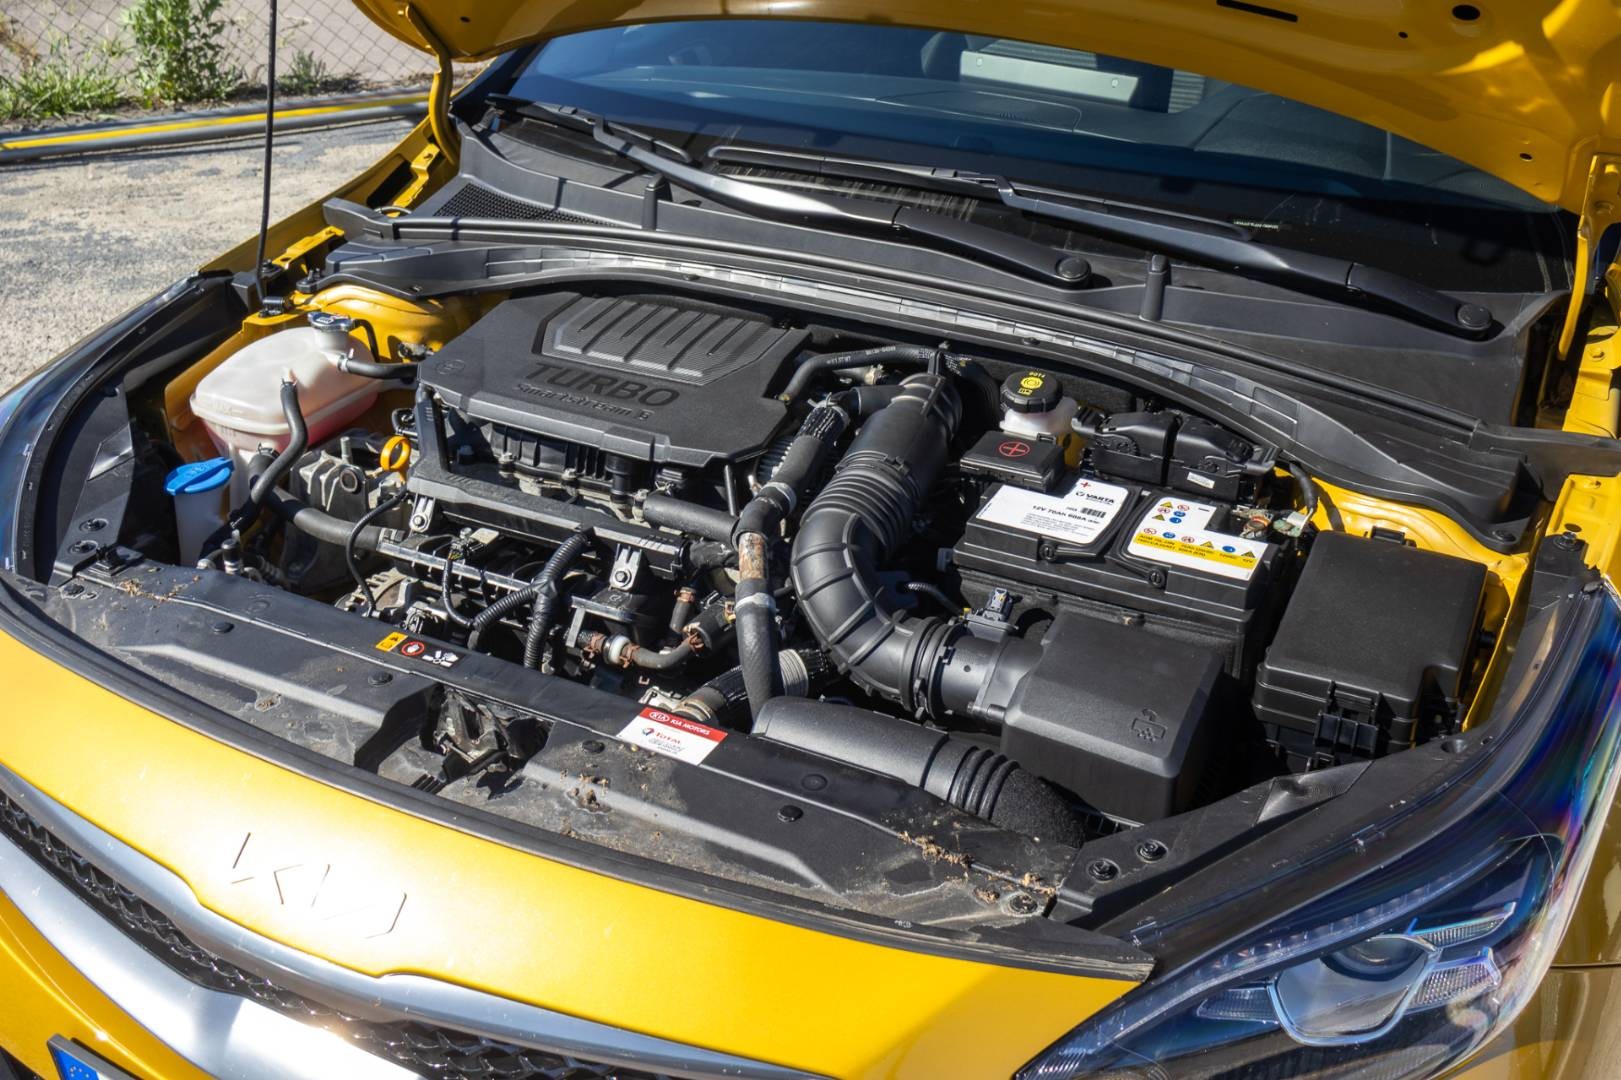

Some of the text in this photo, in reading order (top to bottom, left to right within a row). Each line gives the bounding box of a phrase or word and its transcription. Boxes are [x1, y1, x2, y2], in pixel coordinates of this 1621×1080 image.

[526, 362, 680, 406] TURBO
[1086, 493, 1114, 504] VARTA
[670, 719, 682, 727] KIA
[682, 722, 710, 735] MOTORS
